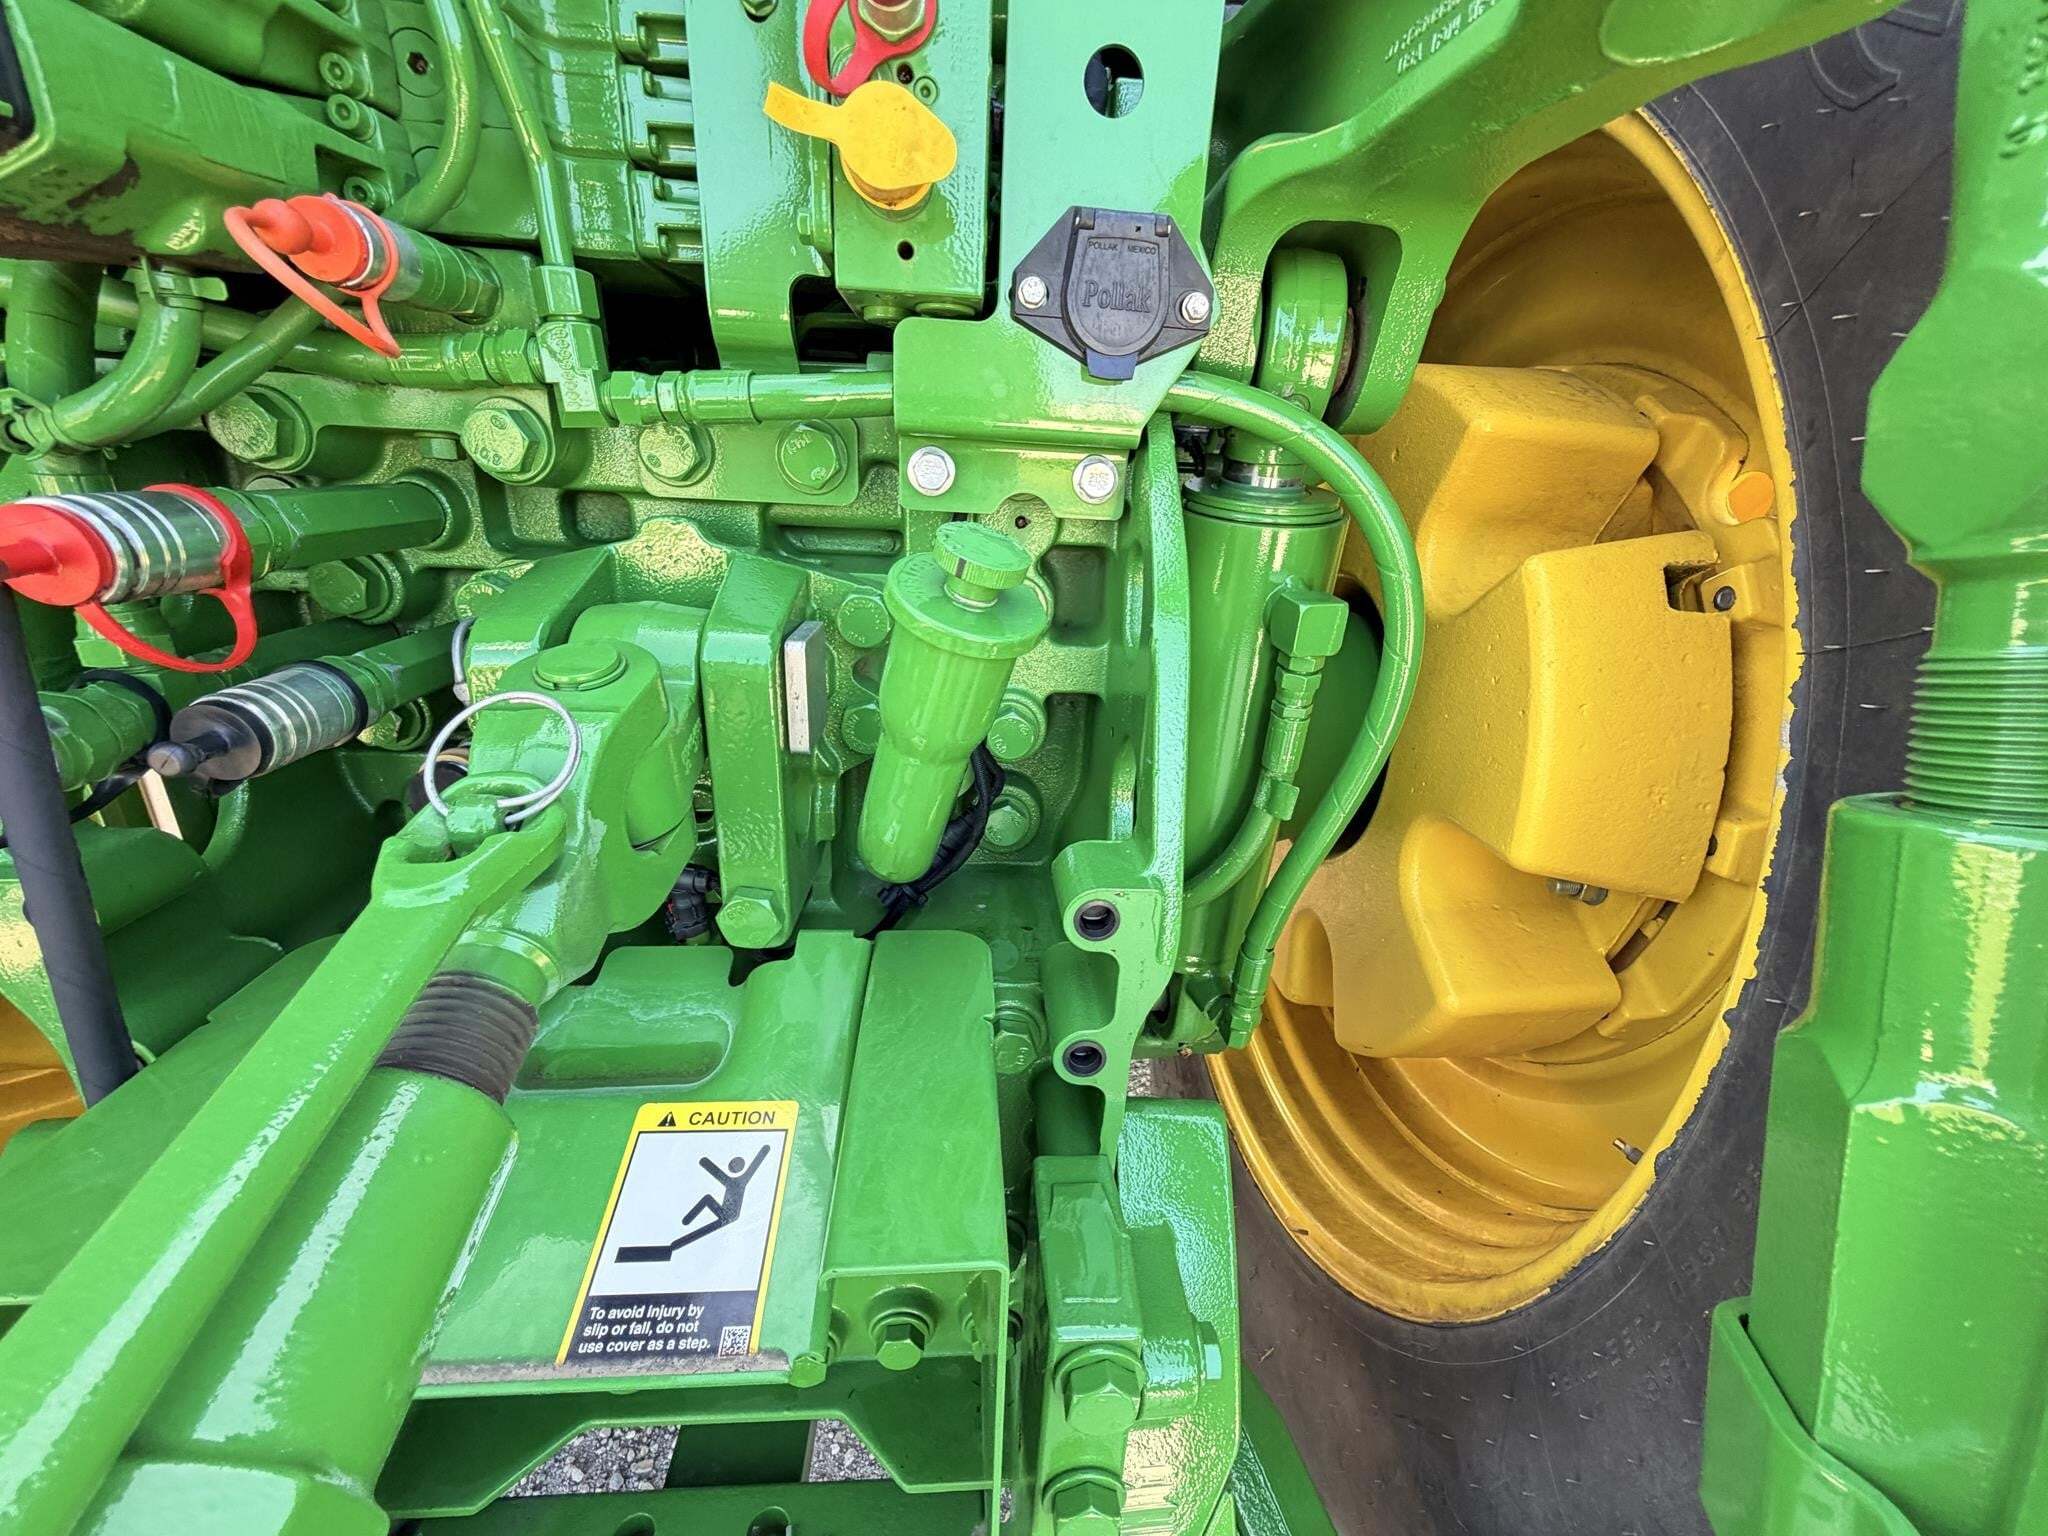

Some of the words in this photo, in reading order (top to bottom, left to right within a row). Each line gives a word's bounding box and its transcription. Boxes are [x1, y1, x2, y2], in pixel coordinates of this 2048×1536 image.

[1088, 241, 1118, 251] POLLAK
[1082, 279, 1151, 314] Pollak
[689, 1111, 776, 1126] CAUTION
[590, 1306, 605, 1320] To
[607, 1305, 646, 1319] avoid
[646, 1304, 685, 1320] injury
[687, 1303, 705, 1319] by
[583, 1322, 608, 1339] slip
[611, 1323, 627, 1336] or
[628, 1321, 653, 1337] fall,
[656, 1320, 674, 1334] do
[676, 1320, 700, 1333] not
[578, 1341, 604, 1354] use
[606, 1340, 645, 1353] cover
[646, 1339, 664, 1352] as
[666, 1340, 676, 1351] a
[677, 1337, 712, 1352] step.
